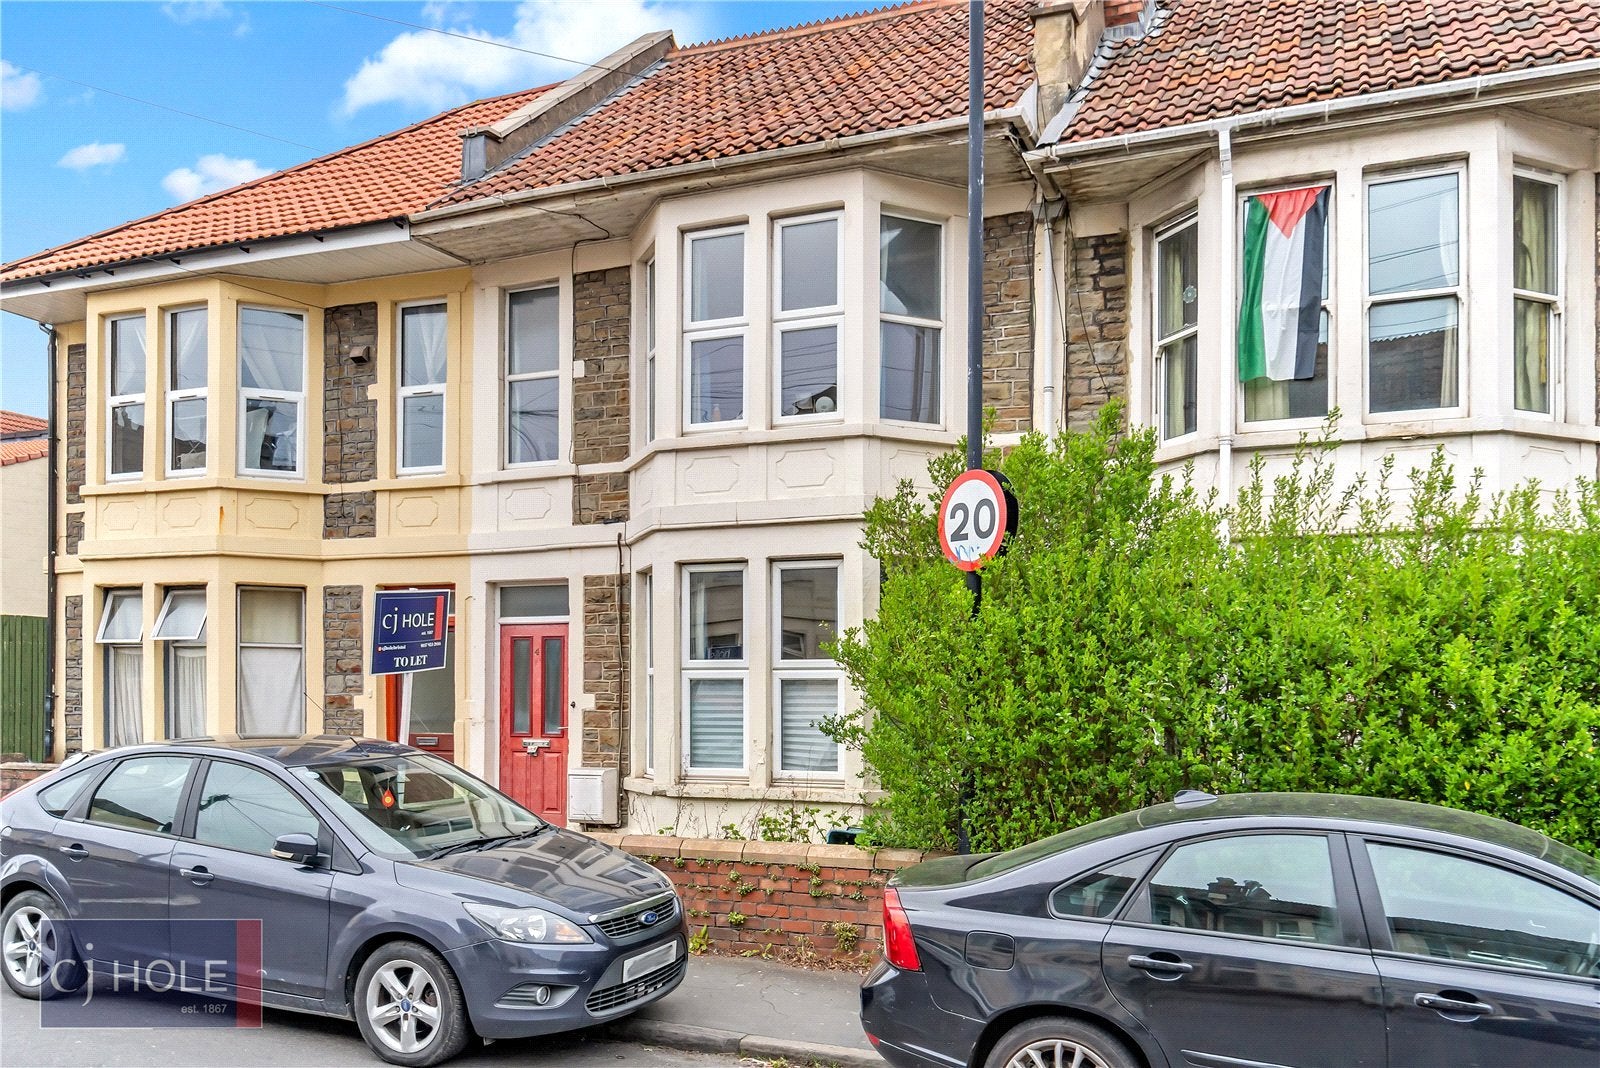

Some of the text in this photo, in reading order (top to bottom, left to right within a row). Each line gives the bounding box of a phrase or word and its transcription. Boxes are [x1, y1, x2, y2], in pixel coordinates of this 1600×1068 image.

[950, 498, 996, 542] 20
[402, 612, 435, 628] HOLE
[394, 654, 428, 668] TO LET
